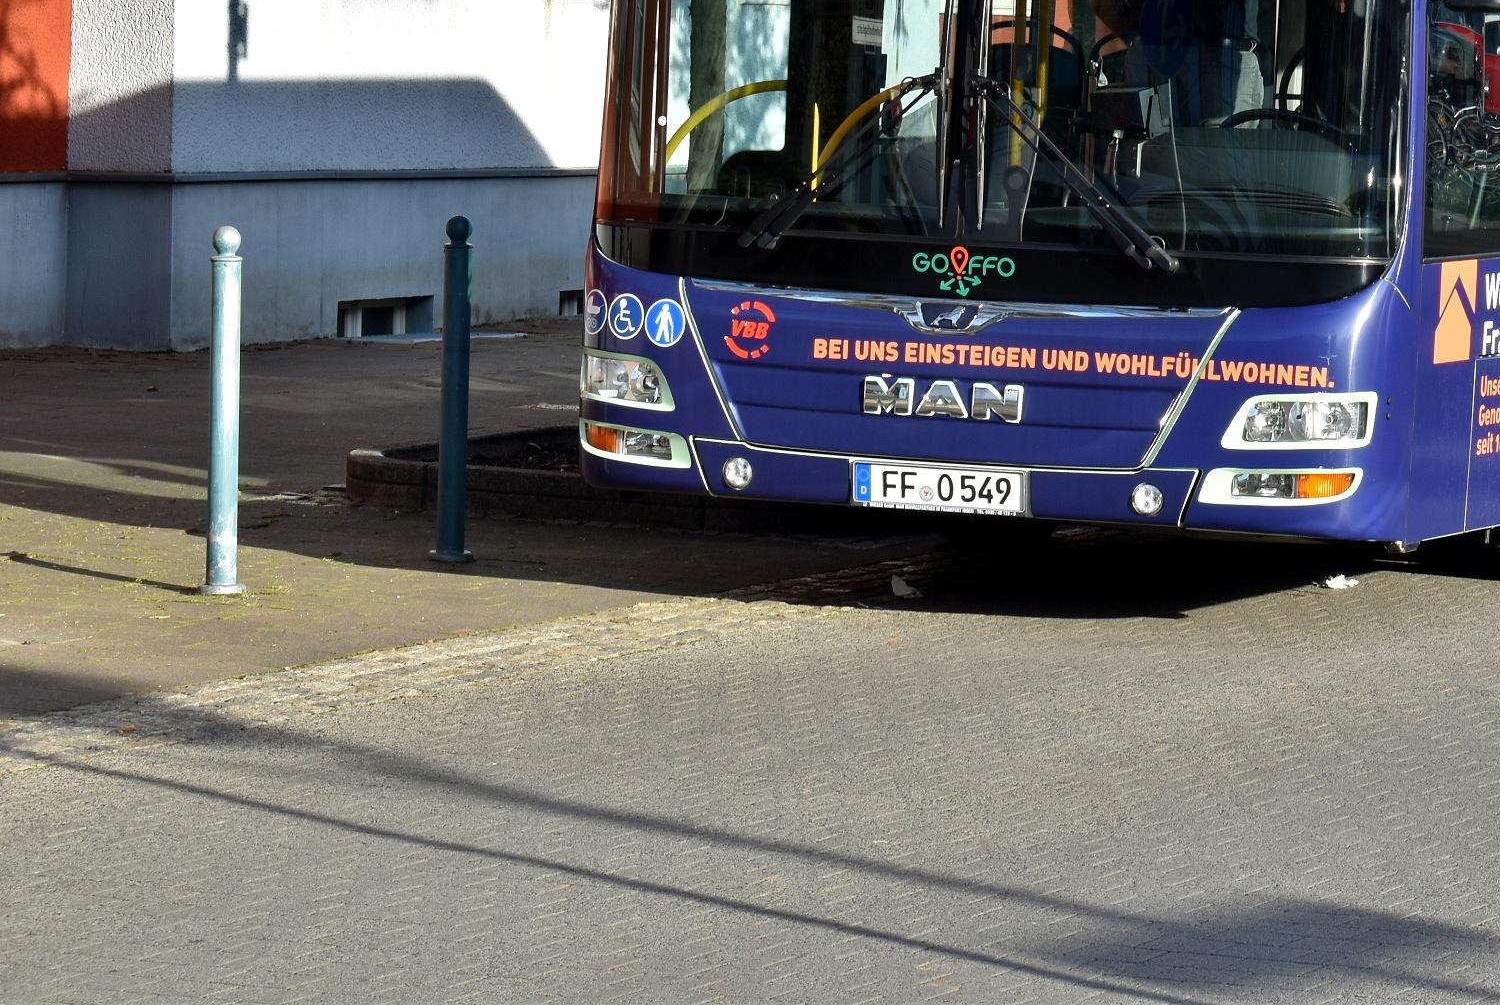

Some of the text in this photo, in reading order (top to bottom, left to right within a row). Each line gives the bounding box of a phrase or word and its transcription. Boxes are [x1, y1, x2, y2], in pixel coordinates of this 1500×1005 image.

[732, 319, 770, 340] VBB
[813, 338, 849, 360] BEI
[854, 340, 899, 363] UNS
[904, 342, 1036, 369] EINSTEIGEN
[1042, 349, 1089, 373] UND
[862, 374, 1025, 425] MAN
[1476, 432, 1494, 456] seit
[882, 470, 917, 499] FF
